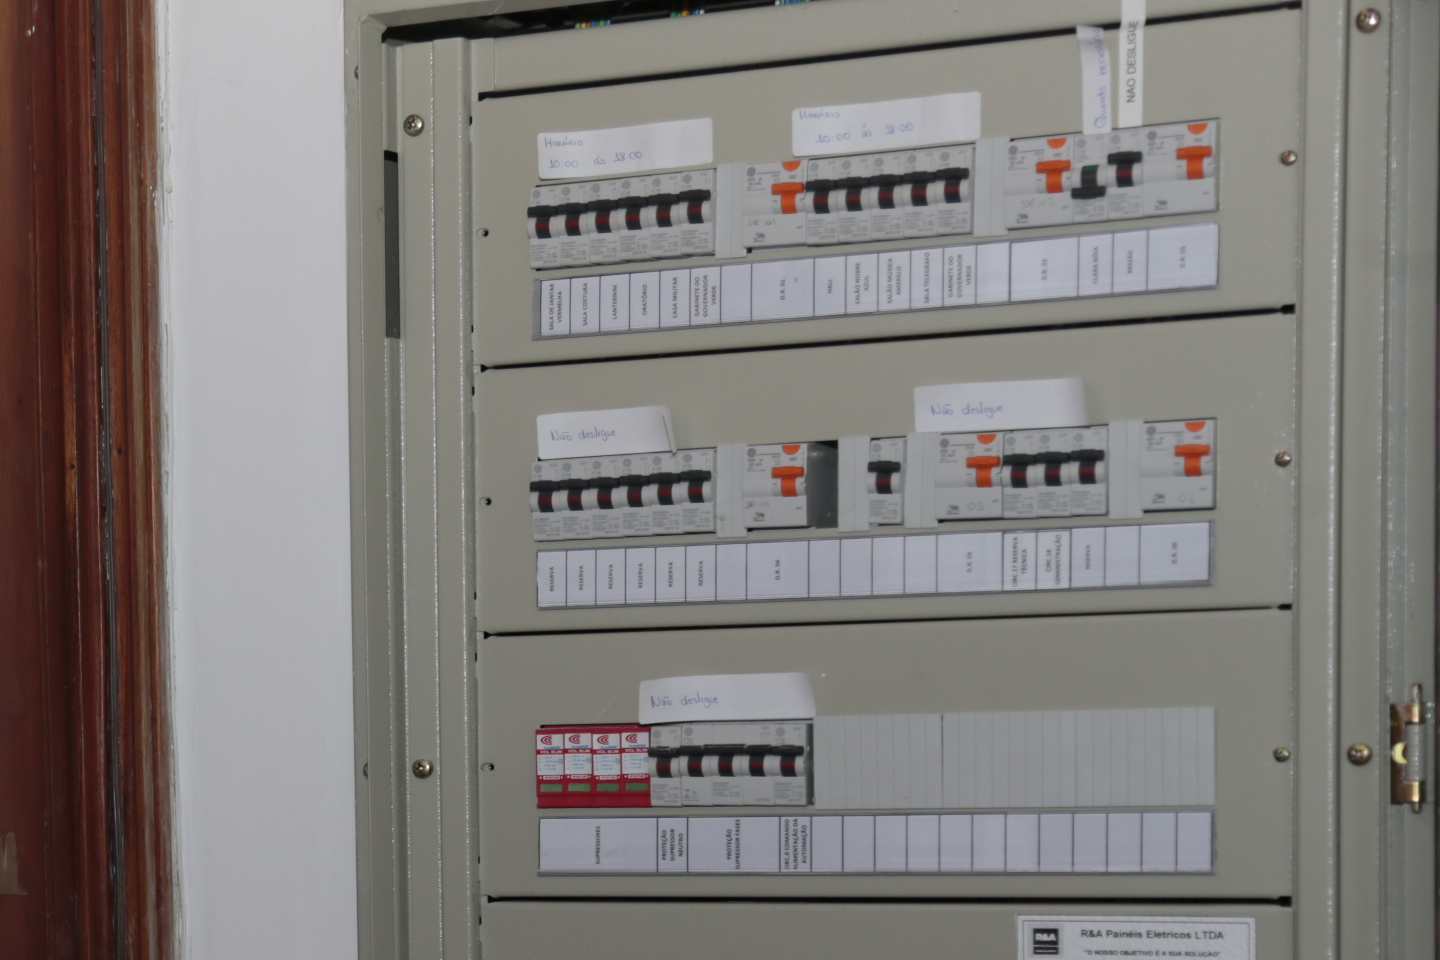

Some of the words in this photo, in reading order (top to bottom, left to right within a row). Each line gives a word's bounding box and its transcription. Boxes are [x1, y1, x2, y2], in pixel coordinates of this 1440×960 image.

[1126, 20, 1138, 75] DESLIGUE
[1126, 78, 1136, 103] NAO
[948, 256, 954, 265] DO
[780, 279, 785, 287] 01
[549, 306, 554, 314] DE
[793, 818, 798, 827] DA
[725, 829, 733, 860] PROTEÇÃO
[1035, 933, 1057, 942] R&A
[1081, 929, 1103, 938] R&A
[1106, 929, 1143, 939] Painéis
[1146, 930, 1192, 940] Eletricos
[1195, 930, 1225, 940] LTDA
